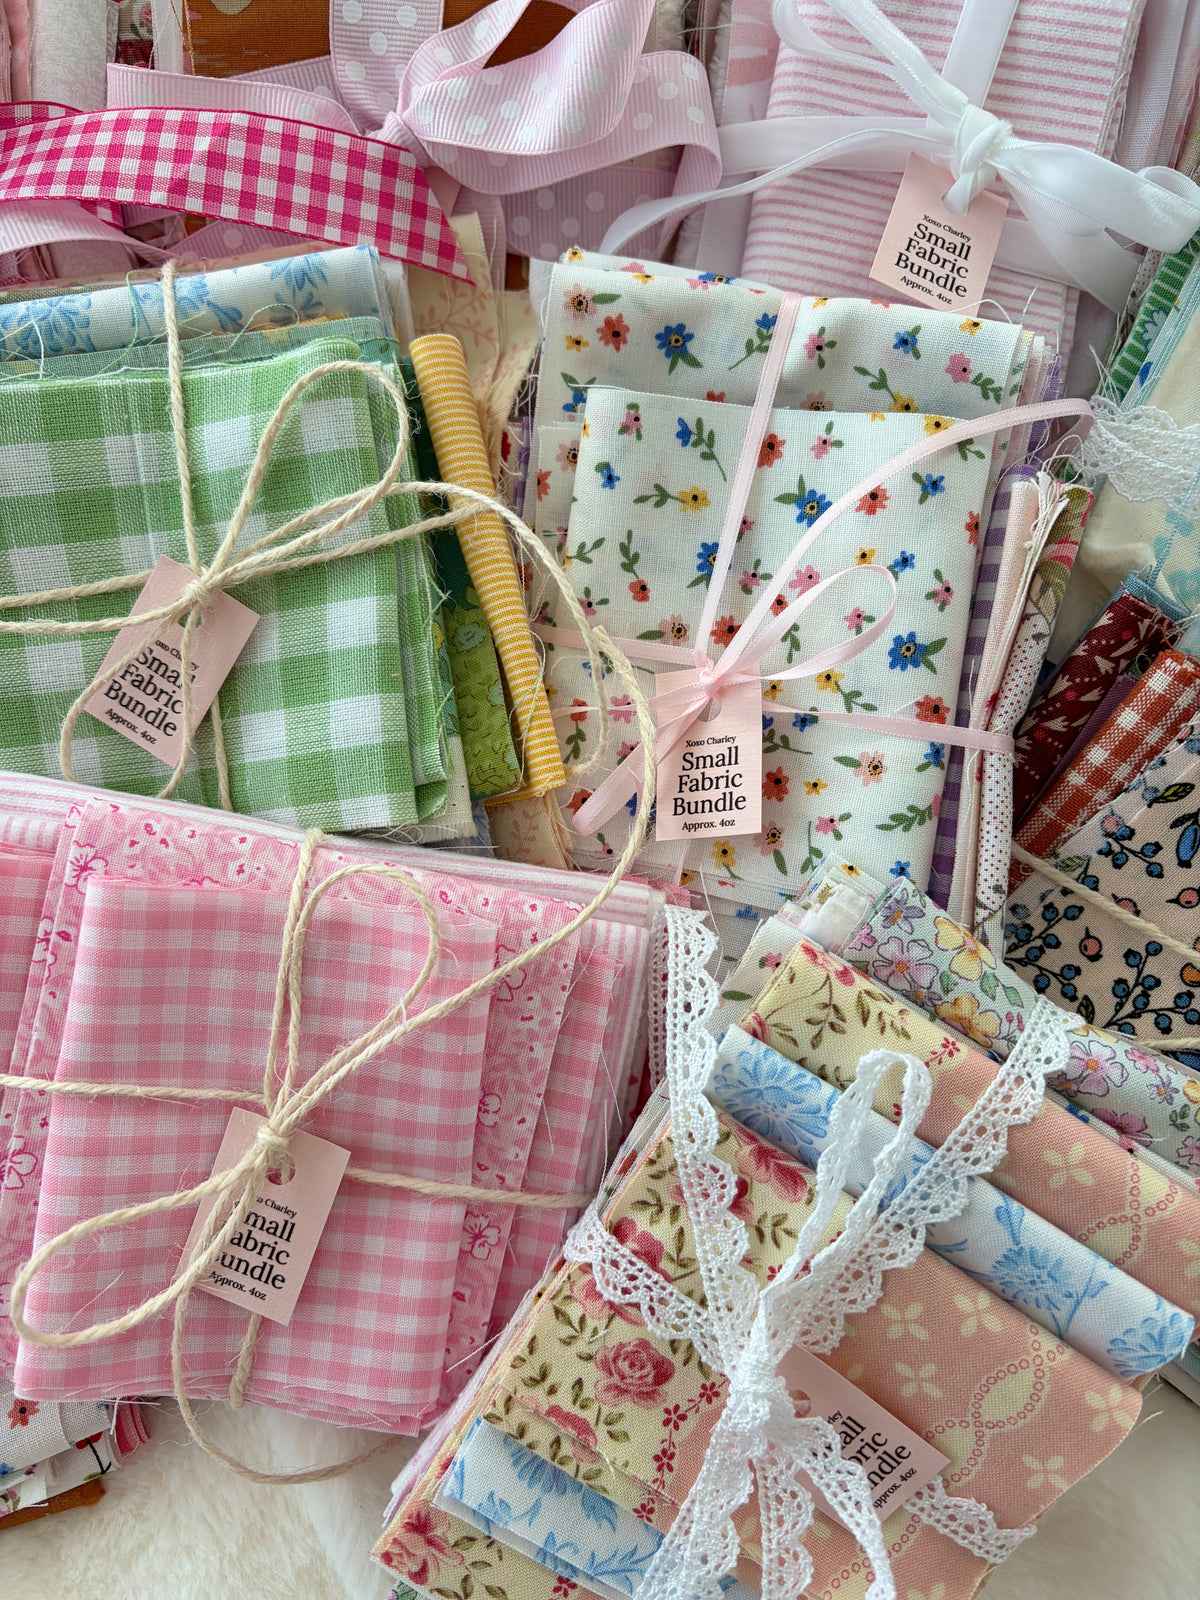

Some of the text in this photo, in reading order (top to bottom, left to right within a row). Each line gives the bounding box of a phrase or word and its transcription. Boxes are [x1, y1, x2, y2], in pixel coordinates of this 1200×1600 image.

[913, 223, 972, 261] Small
[922, 214, 972, 242] Xoxo Charley
[904, 237, 969, 279] Fabric
[894, 251, 968, 298] Bundle
[899, 275, 952, 305] Approx. 4oz
[155, 639, 170, 652] oxo
[104, 678, 177, 737] Bundle
[105, 708, 157, 745] Approx. 4oz
[685, 735, 737, 748] Xoxo Charley
[682, 745, 740, 772] Small
[677, 769, 743, 794] Fabric
[672, 791, 747, 817] Bundle
[682, 818, 736, 833] Approx. 4oz
[264, 1198, 298, 1219] Charley
[237, 1207, 296, 1243] mall
[228, 1228, 290, 1265] abric
[216, 1251, 286, 1290] undle
[248, 1287, 268, 1301] 4oz
[866, 1445, 912, 1491] ndle
[899, 1467, 917, 1482] 4oz
